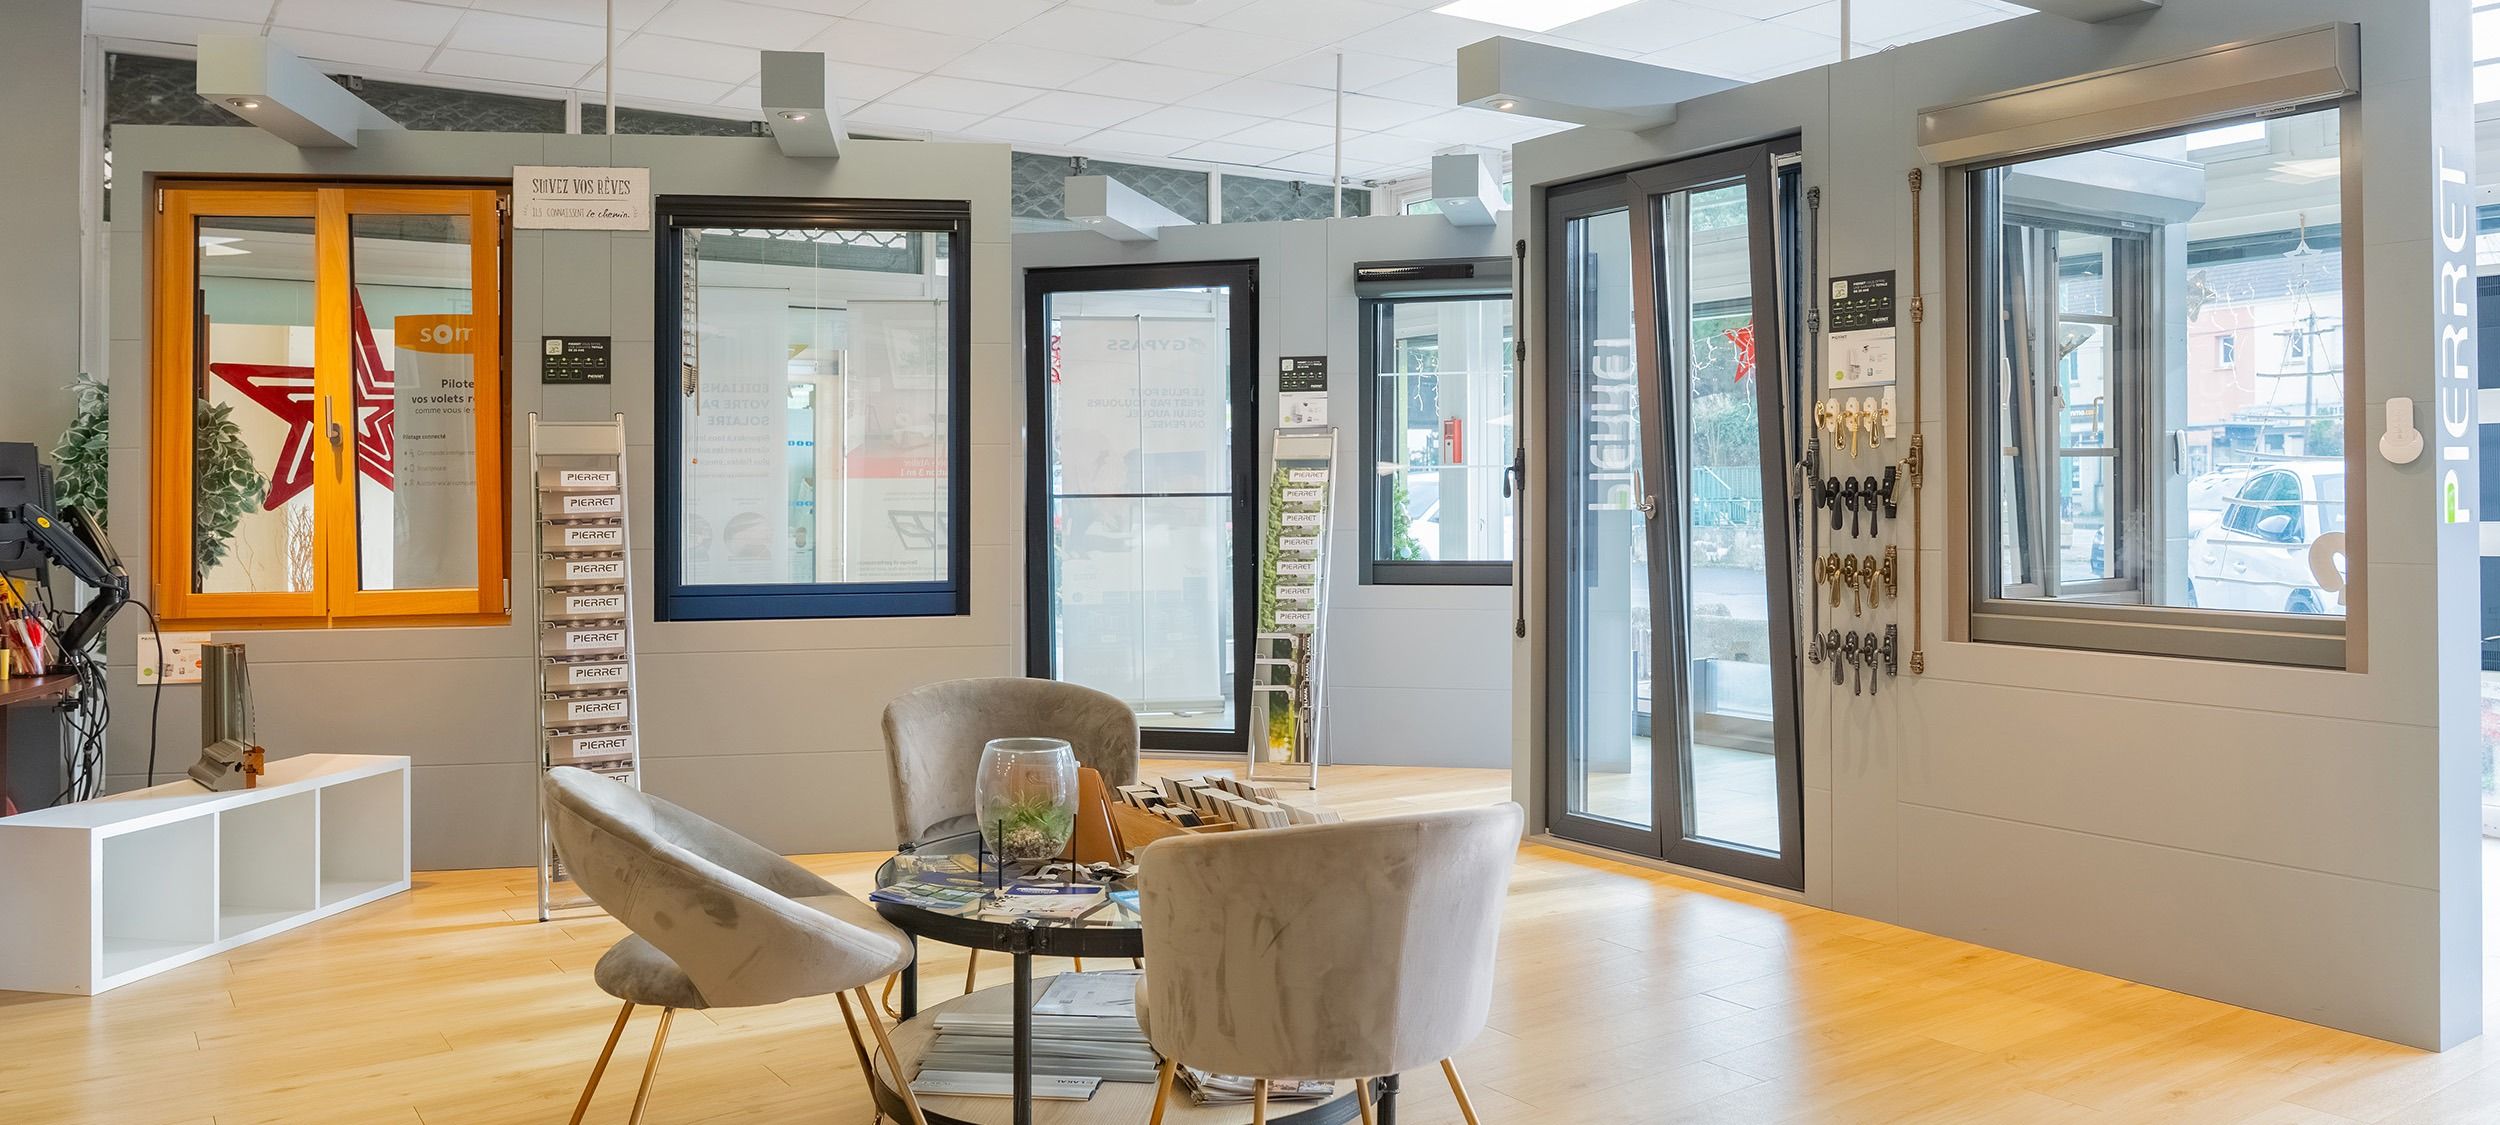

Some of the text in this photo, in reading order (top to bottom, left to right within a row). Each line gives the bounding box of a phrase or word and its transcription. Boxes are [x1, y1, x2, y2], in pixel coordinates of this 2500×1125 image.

[532, 176, 631, 195] SUIVEZ VOS RÊVES
[2439, 145, 2471, 524] PIERRET
[430, 393, 464, 403] volets
[567, 473, 611, 482] PIERRET
[570, 497, 615, 507] PIERRET
[1286, 514, 1317, 522] PIERRET
[571, 530, 617, 540] PIERRET
[1283, 538, 1314, 546] PIERRET
[573, 563, 618, 573] PIERRET
[1281, 562, 1312, 570] PIERRET
[1280, 587, 1311, 595] PIERRET
[573, 597, 619, 608] PIERRET
[1279, 611, 1311, 620] PIERRET
[573, 632, 619, 643] PIERRET
[576, 667, 622, 678] PIERRET
[575, 702, 622, 713] PIERRET
[580, 738, 627, 750] PIERRET
